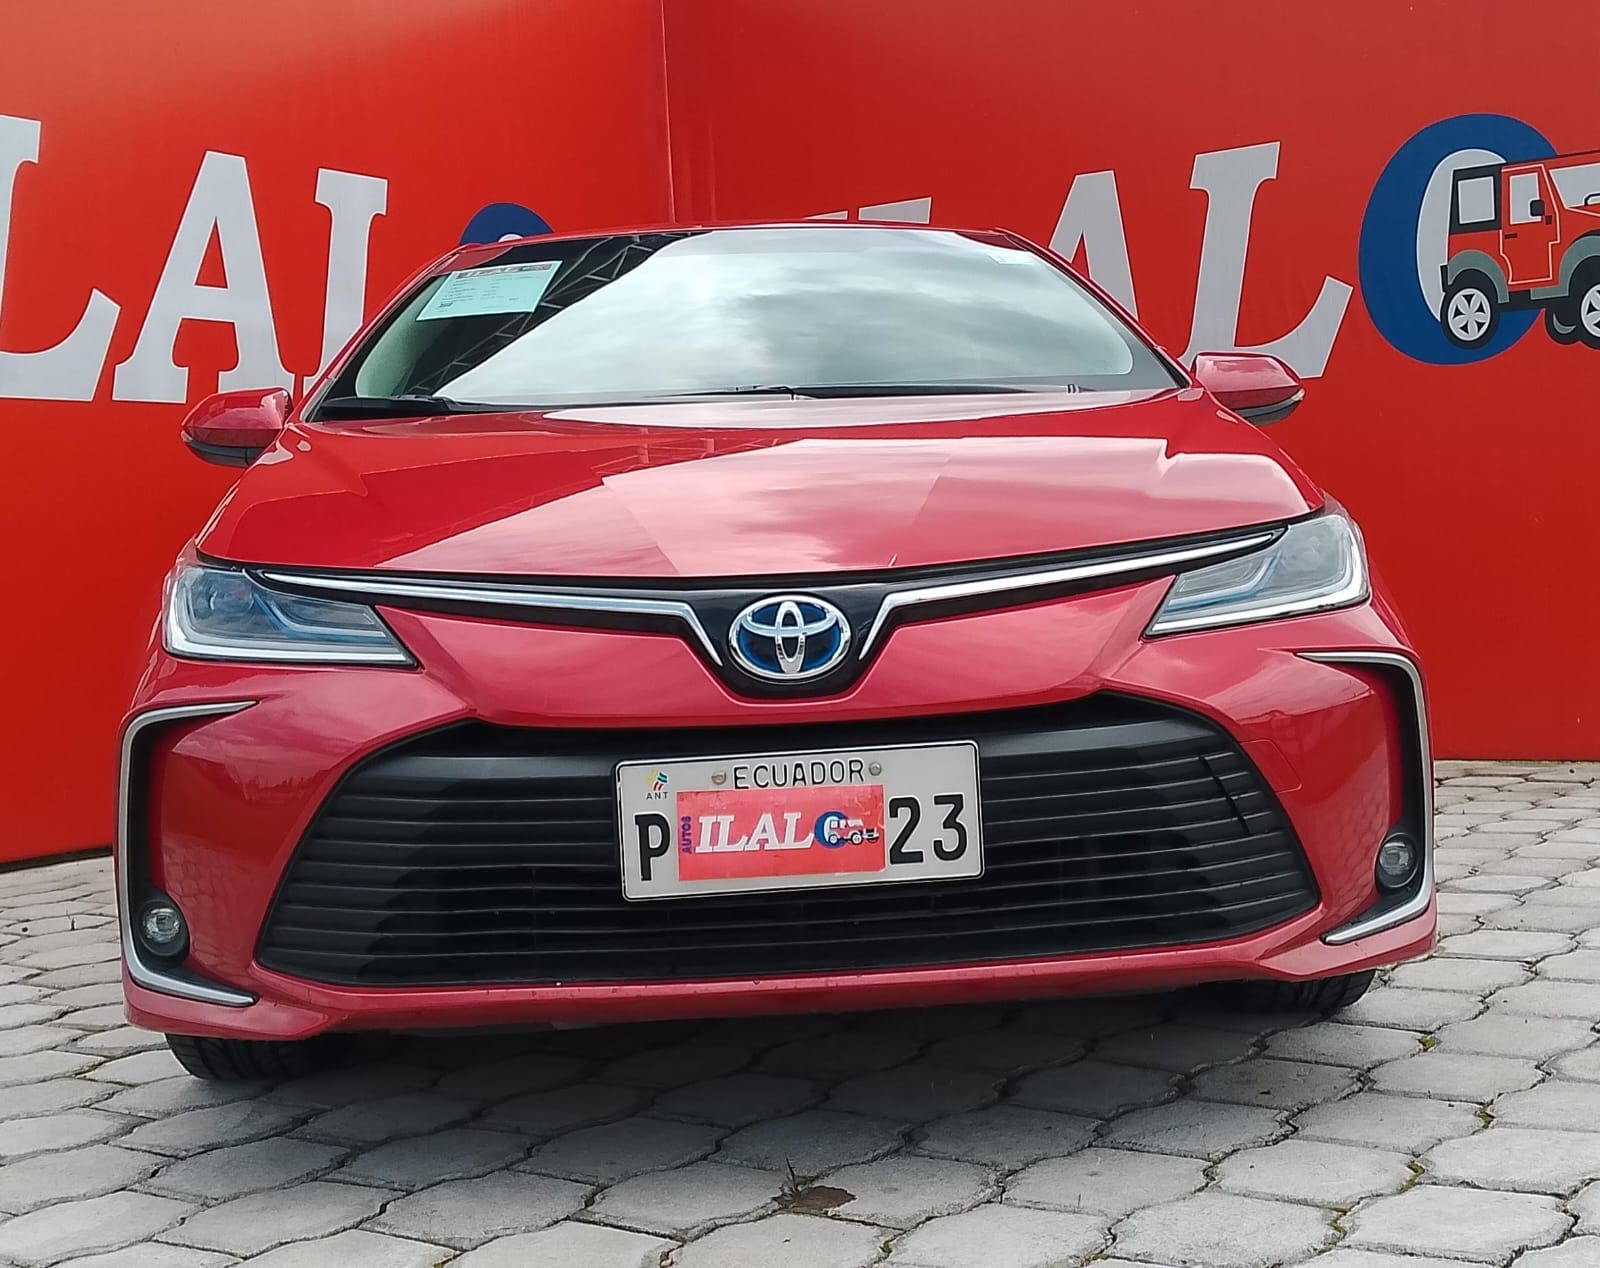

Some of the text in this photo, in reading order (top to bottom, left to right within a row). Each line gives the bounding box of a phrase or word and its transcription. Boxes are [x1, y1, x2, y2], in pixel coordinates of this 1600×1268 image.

[733, 759, 865, 789] ECUADOR
[646, 791, 669, 801] ANT
[634, 812, 672, 882] P
[681, 816, 692, 854] AUTOS
[888, 794, 968, 865] 23
